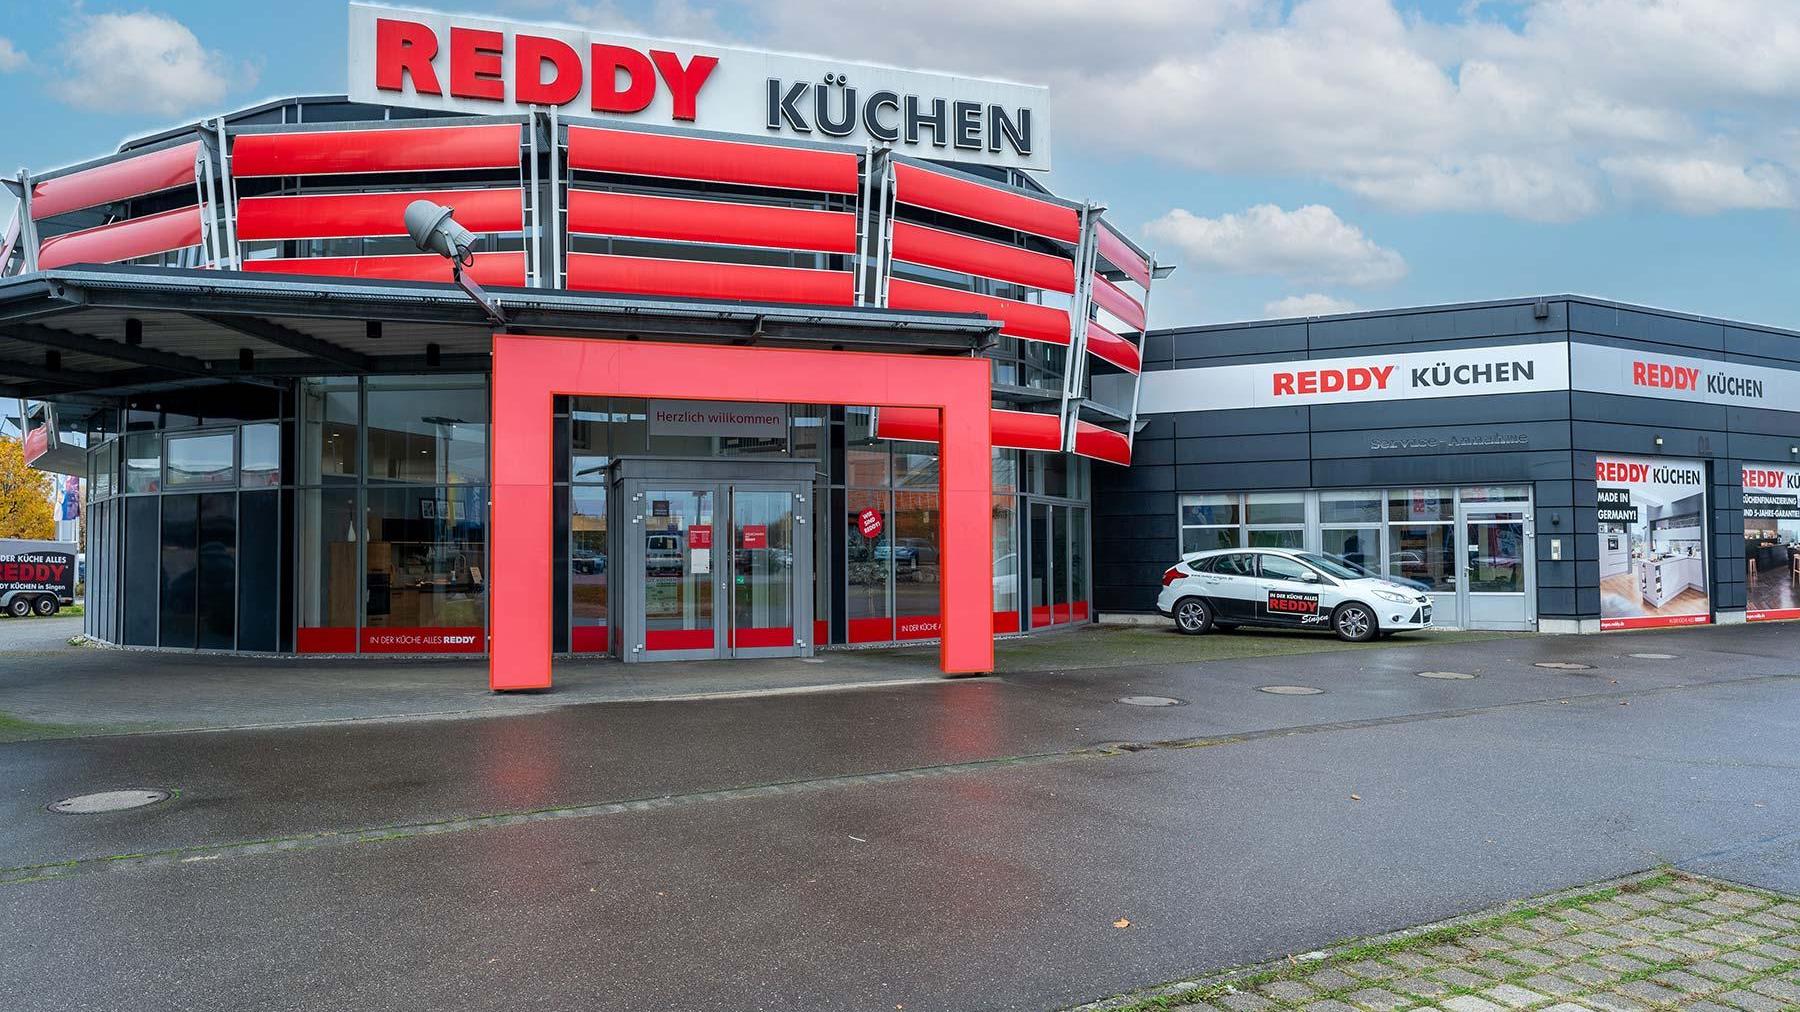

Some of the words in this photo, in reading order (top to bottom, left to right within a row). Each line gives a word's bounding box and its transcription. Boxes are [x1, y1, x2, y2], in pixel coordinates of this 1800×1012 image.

[377, 18, 719, 122] REDDY
[767, 72, 1032, 156] KÜCHEN
[1273, 366, 1394, 396] REDDY
[1412, 361, 1534, 388] KÜCHEN
[1633, 362, 1699, 391] REDDY
[1707, 373, 1763, 398] KÜCHEN
[656, 411, 704, 423] Herzlich
[708, 412, 780, 424] willkommen
[1595, 462, 1649, 483] REDDY
[1653, 466, 1700, 485] KÜCHEN
[1597, 492, 1619, 502] MADE
[1620, 493, 1629, 503] IN
[1597, 509, 1636, 520] GERMANY!
[17, 554, 44, 563] KÜCHE
[0, 563, 64, 582] EDDY
[10, 582, 37, 590] KÜCHEN
[1270, 599, 1318, 612] REDDY
[370, 636, 379, 644] IN
[380, 636, 395, 644] DER
[396, 634, 421, 644] KÜCHE
[422, 636, 442, 644] ALLES
[443, 636, 475, 644] REDDY
